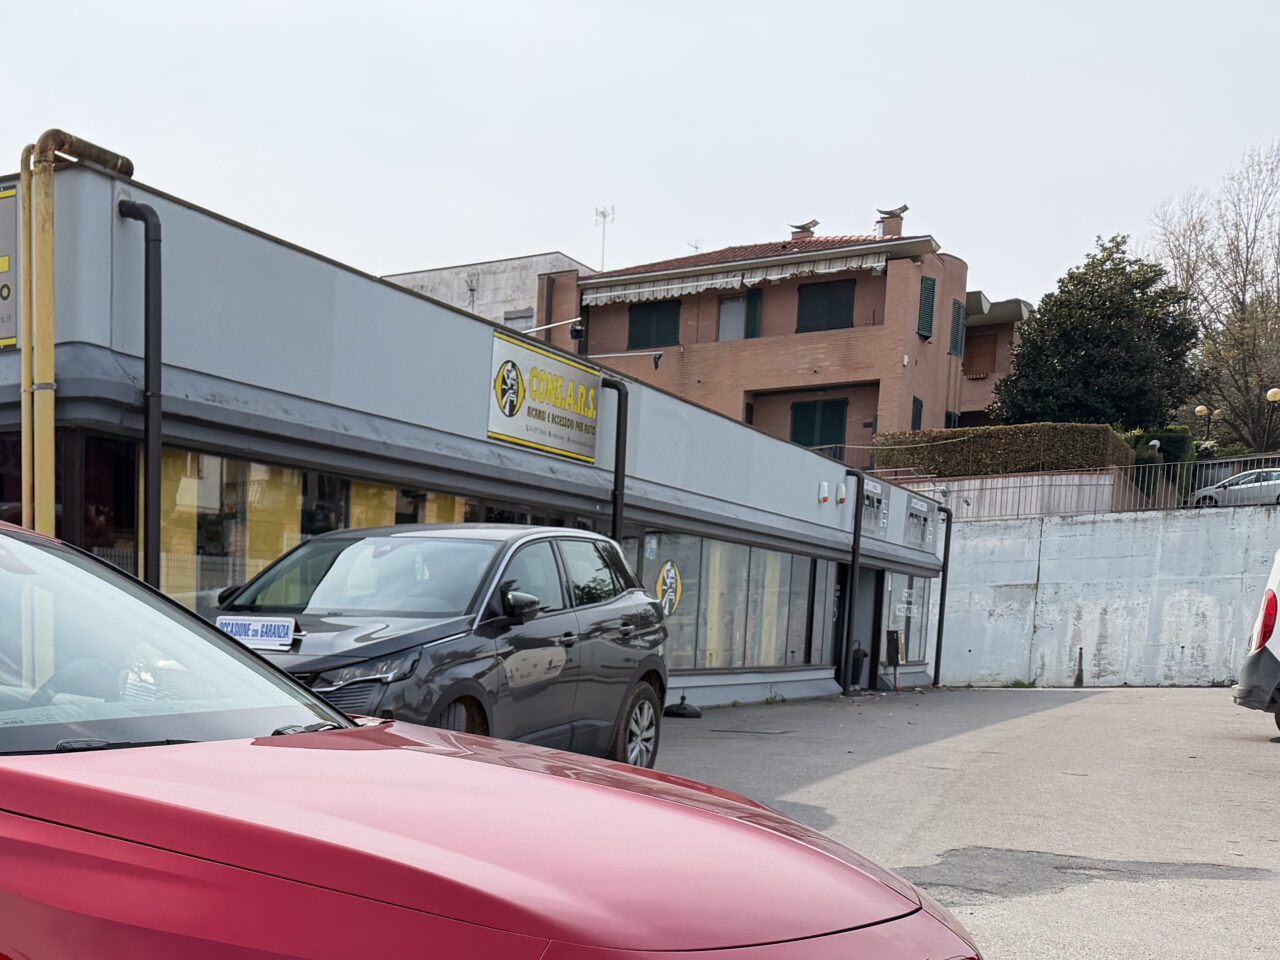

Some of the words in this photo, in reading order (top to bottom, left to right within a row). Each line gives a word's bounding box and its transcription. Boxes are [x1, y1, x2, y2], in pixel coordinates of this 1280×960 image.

[529, 367, 596, 418] CONS.A.R.S.
[527, 405, 546, 421] RICAMBI
[552, 413, 574, 430] ACCESSORI
[575, 420, 584, 433] PER
[260, 624, 289, 638] GARANZIA
